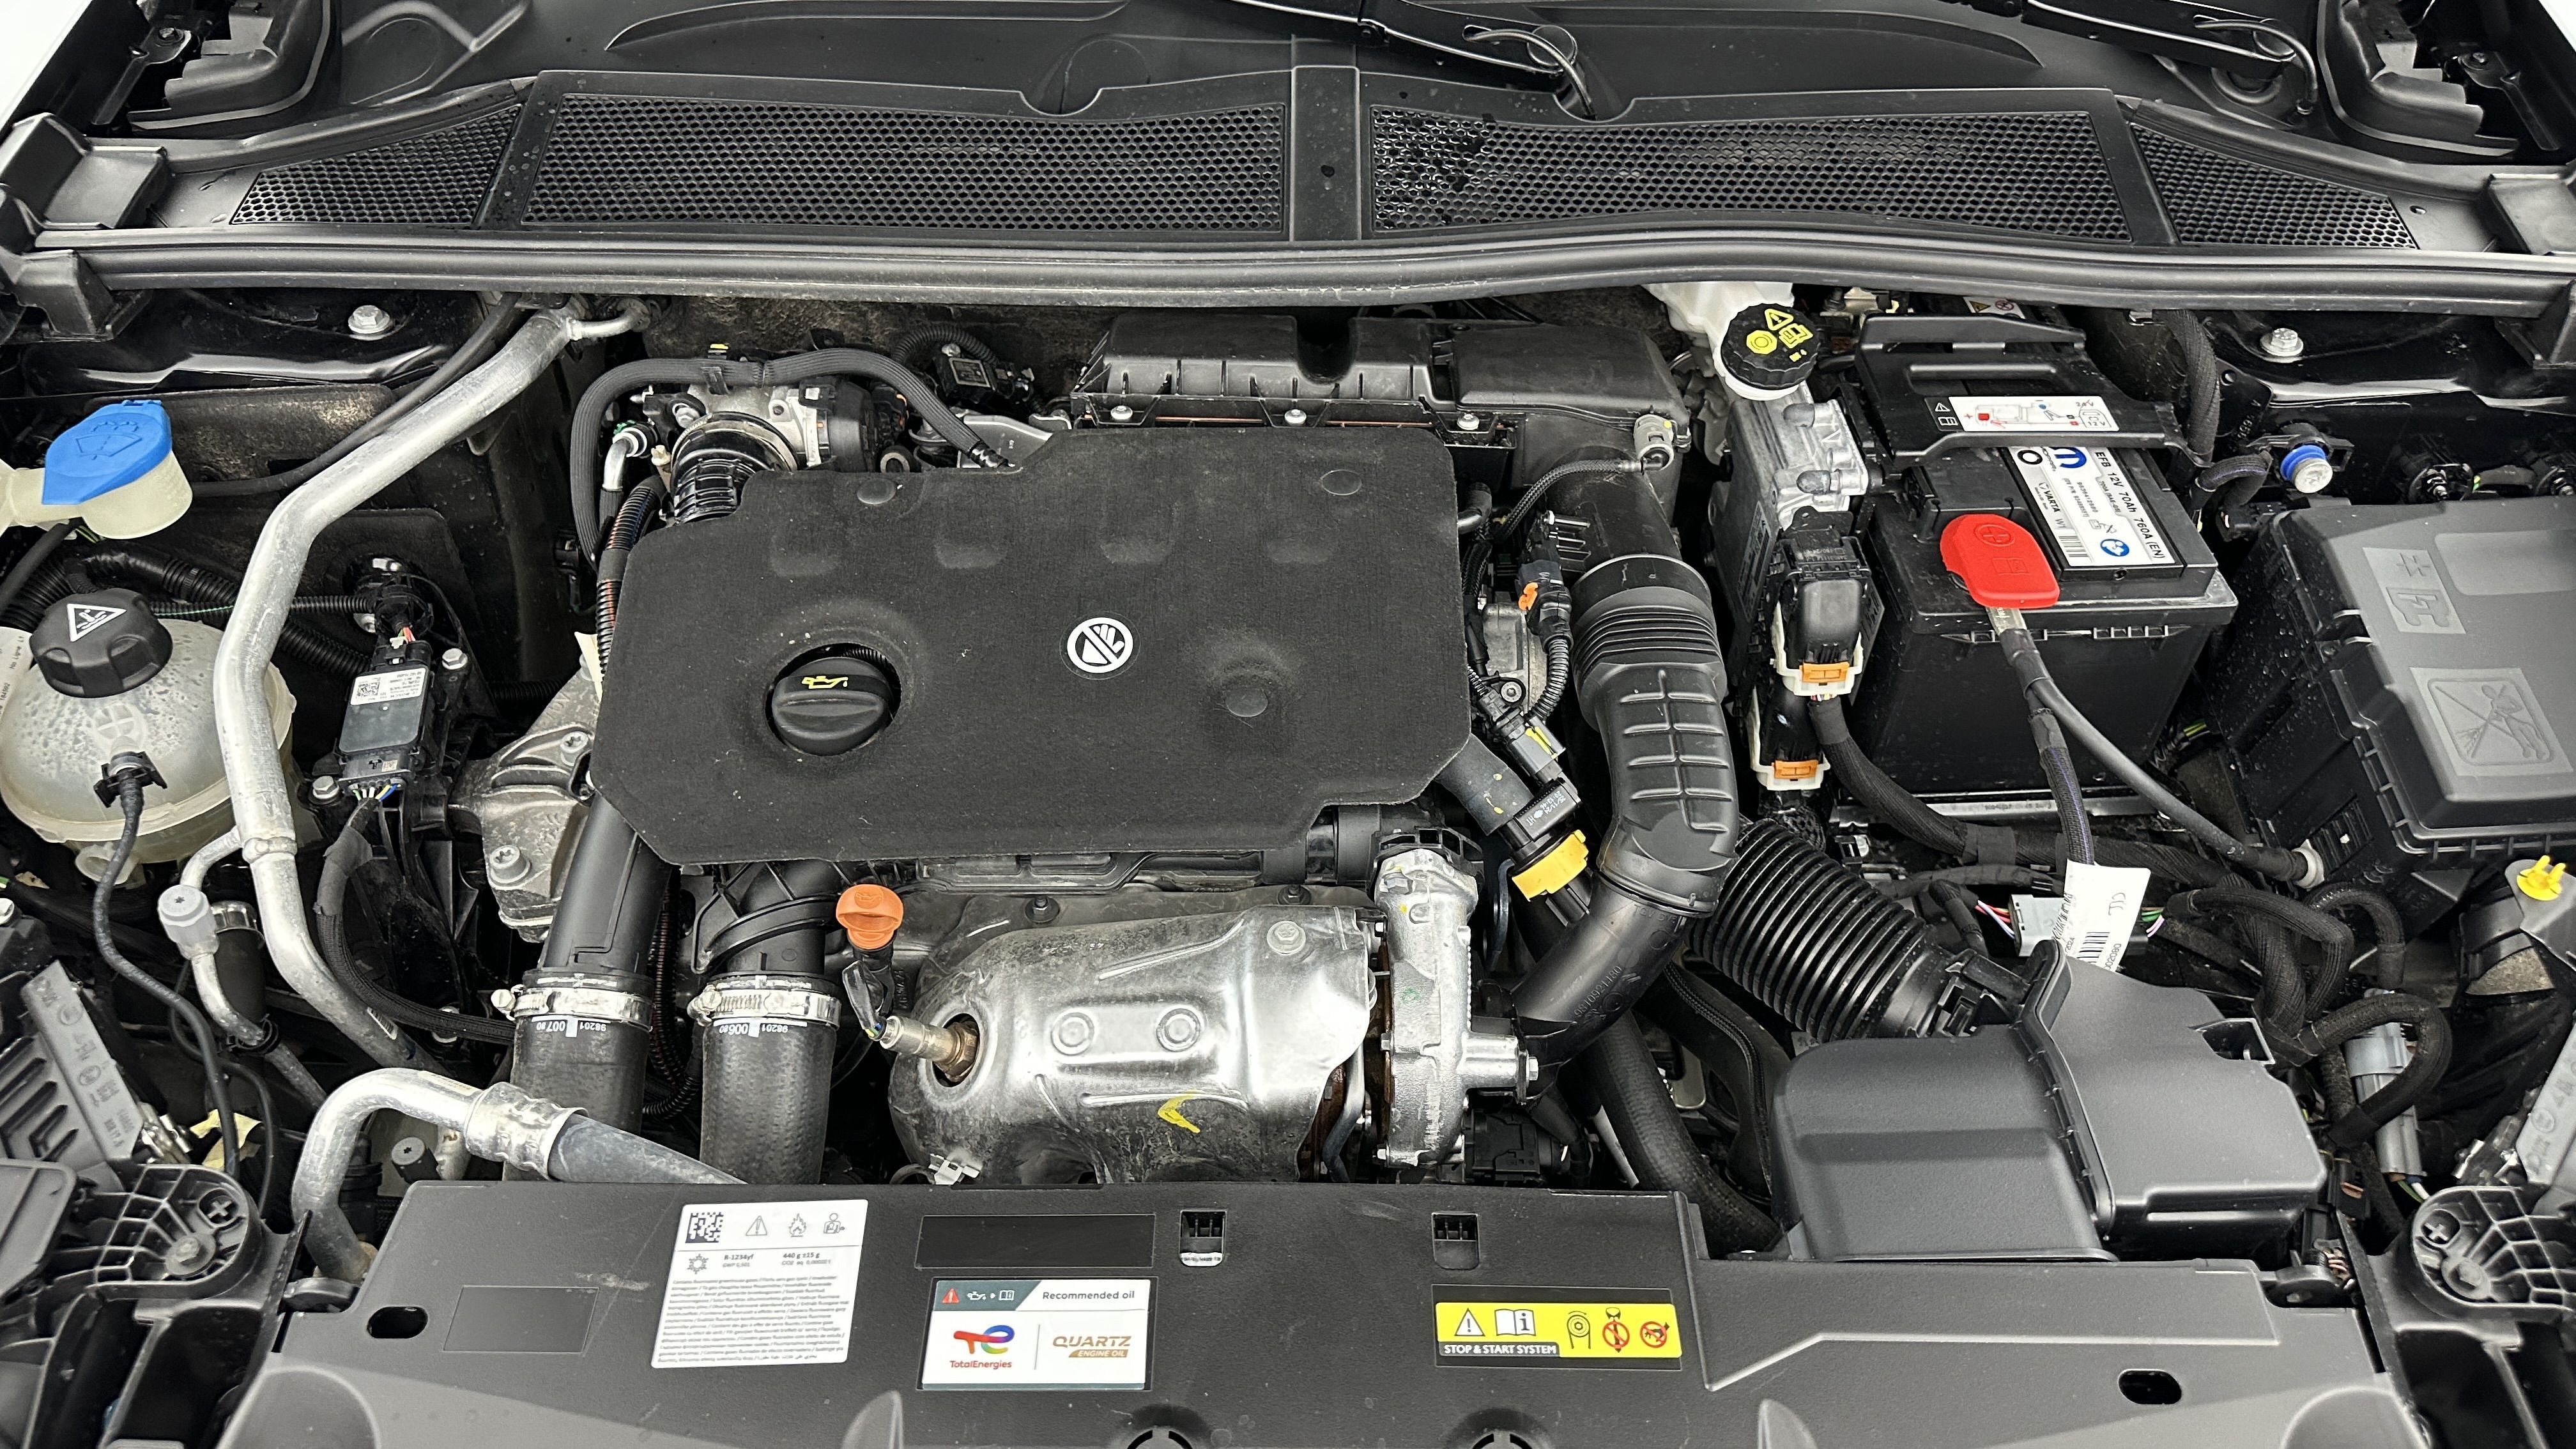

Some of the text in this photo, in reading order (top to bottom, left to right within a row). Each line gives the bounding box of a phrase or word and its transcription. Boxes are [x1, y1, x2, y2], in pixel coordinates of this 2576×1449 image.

[2044, 490, 2061, 512] VARTA
[2095, 452, 2165, 558] EFB 12V 70Ah 760A (EN)
[579, 1022, 607, 1032] 98201
[761, 1023, 789, 1033] 98201
[1043, 1291, 1135, 1300] Recommended oil
[1052, 1335, 1132, 1349] QUARTZ
[1444, 1344, 1557, 1355] STOP & START SYSTEM
[950, 1360, 1013, 1370] TotalEnergies
